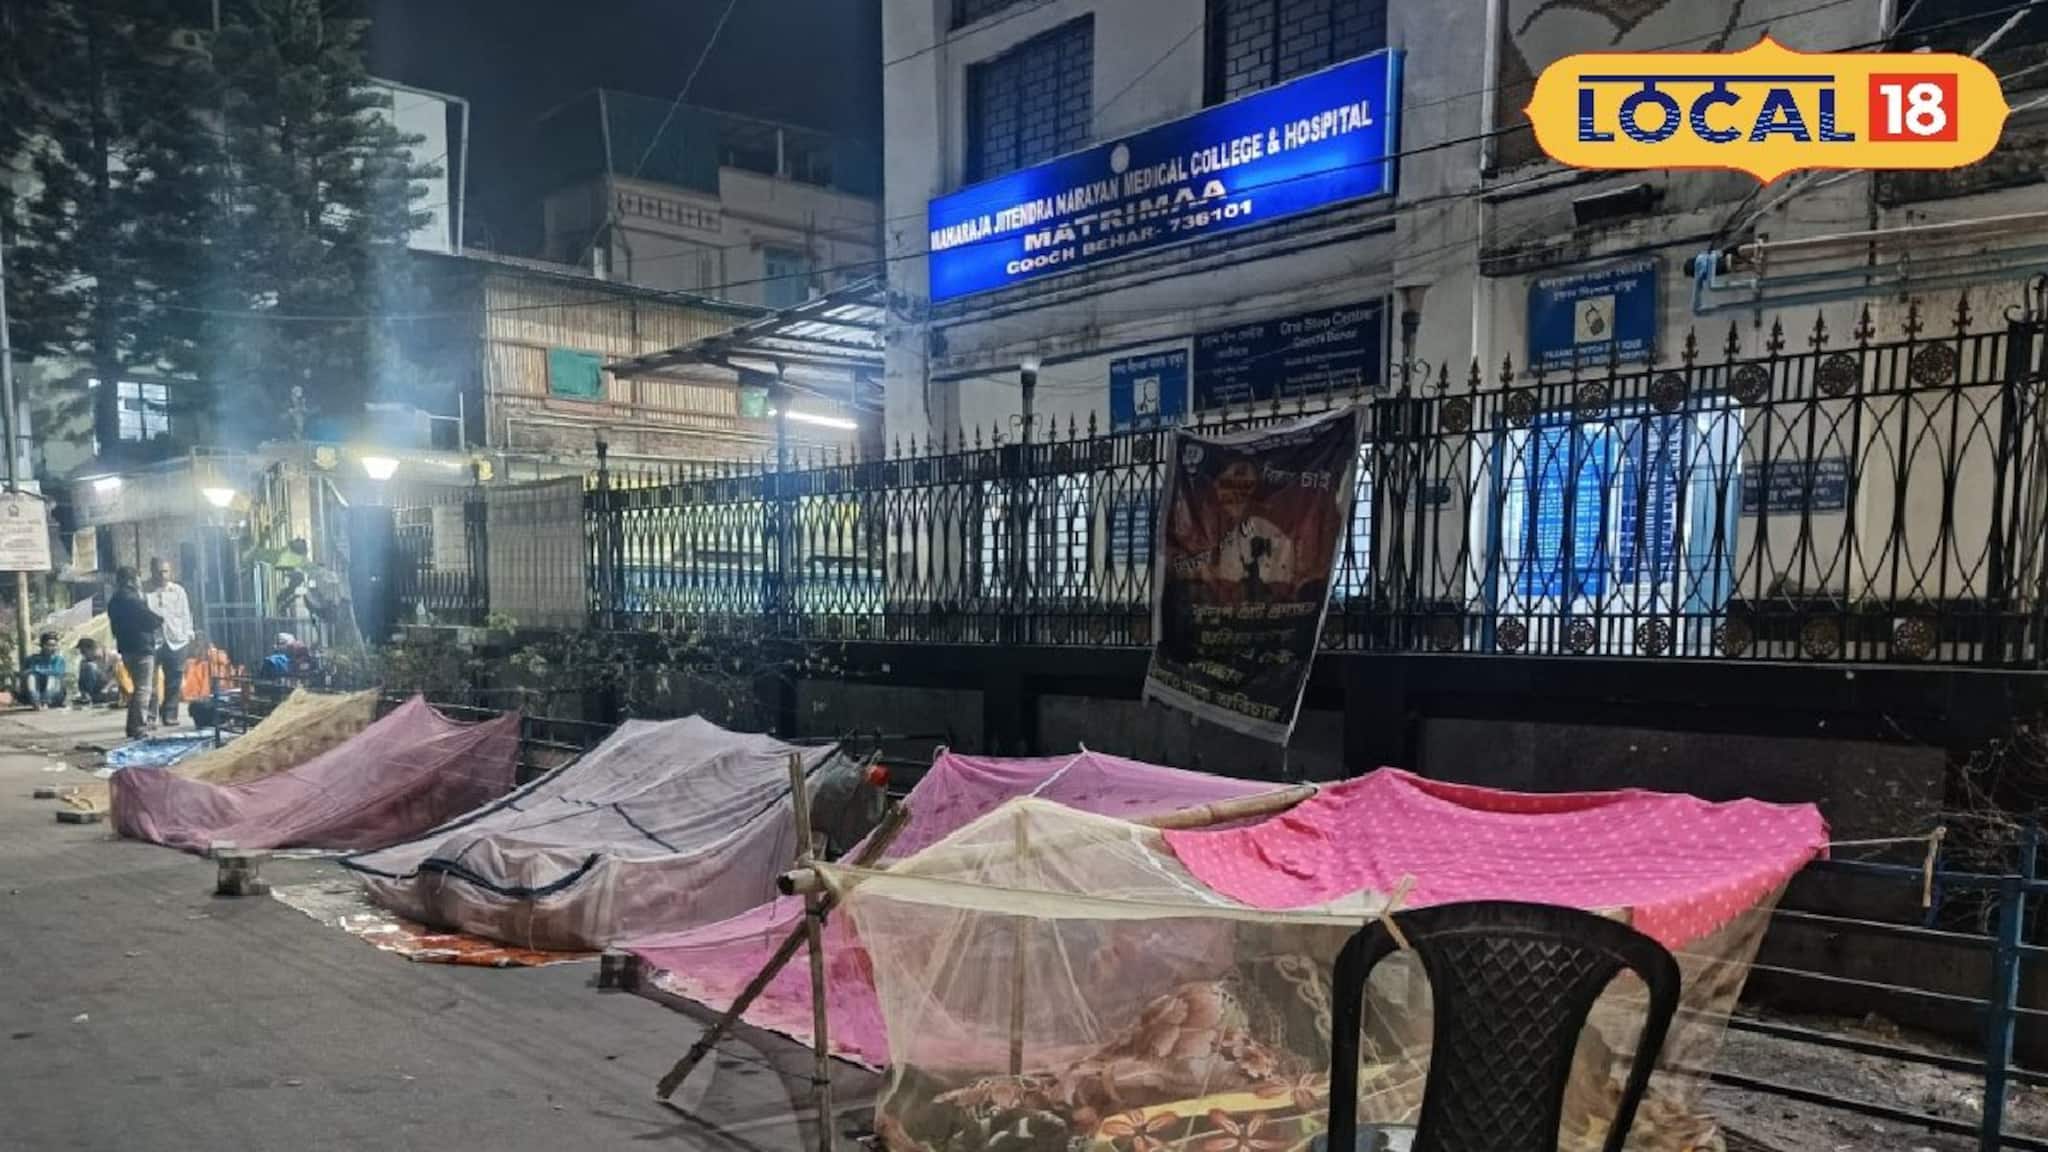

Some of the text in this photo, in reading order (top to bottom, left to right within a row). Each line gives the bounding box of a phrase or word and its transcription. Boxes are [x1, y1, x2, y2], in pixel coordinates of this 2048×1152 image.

[931, 100, 1374, 251] MAHARAJA JITENDRA NARAYAN MEDICAL COLLEGE & HOSPITAL
[1024, 179, 1227, 251] MATRIMAA
[1170, 200, 1252, 231] 736101
